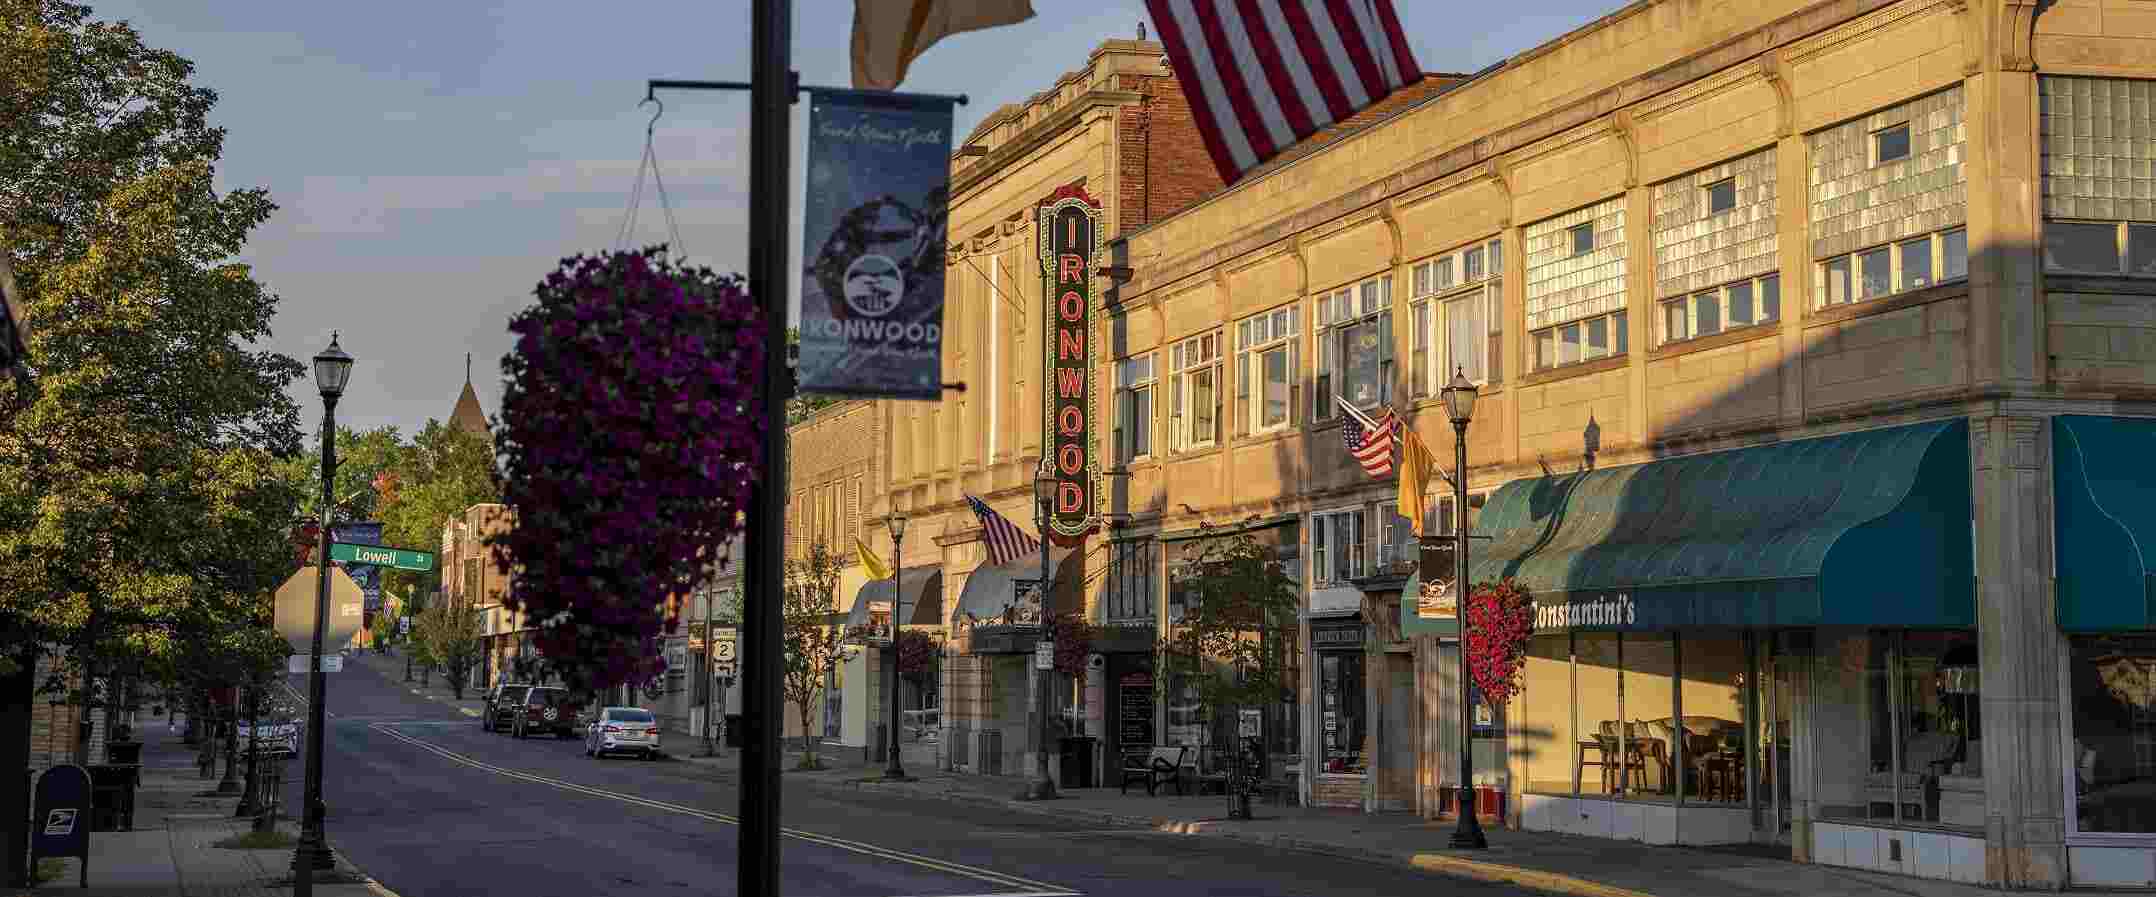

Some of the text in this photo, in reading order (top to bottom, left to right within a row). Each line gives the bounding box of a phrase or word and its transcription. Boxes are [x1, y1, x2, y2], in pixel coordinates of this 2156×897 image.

[1058, 217, 1084, 513] IRONWOOD
[355, 547, 397, 565] Lowell
[719, 644, 729, 656] 2
